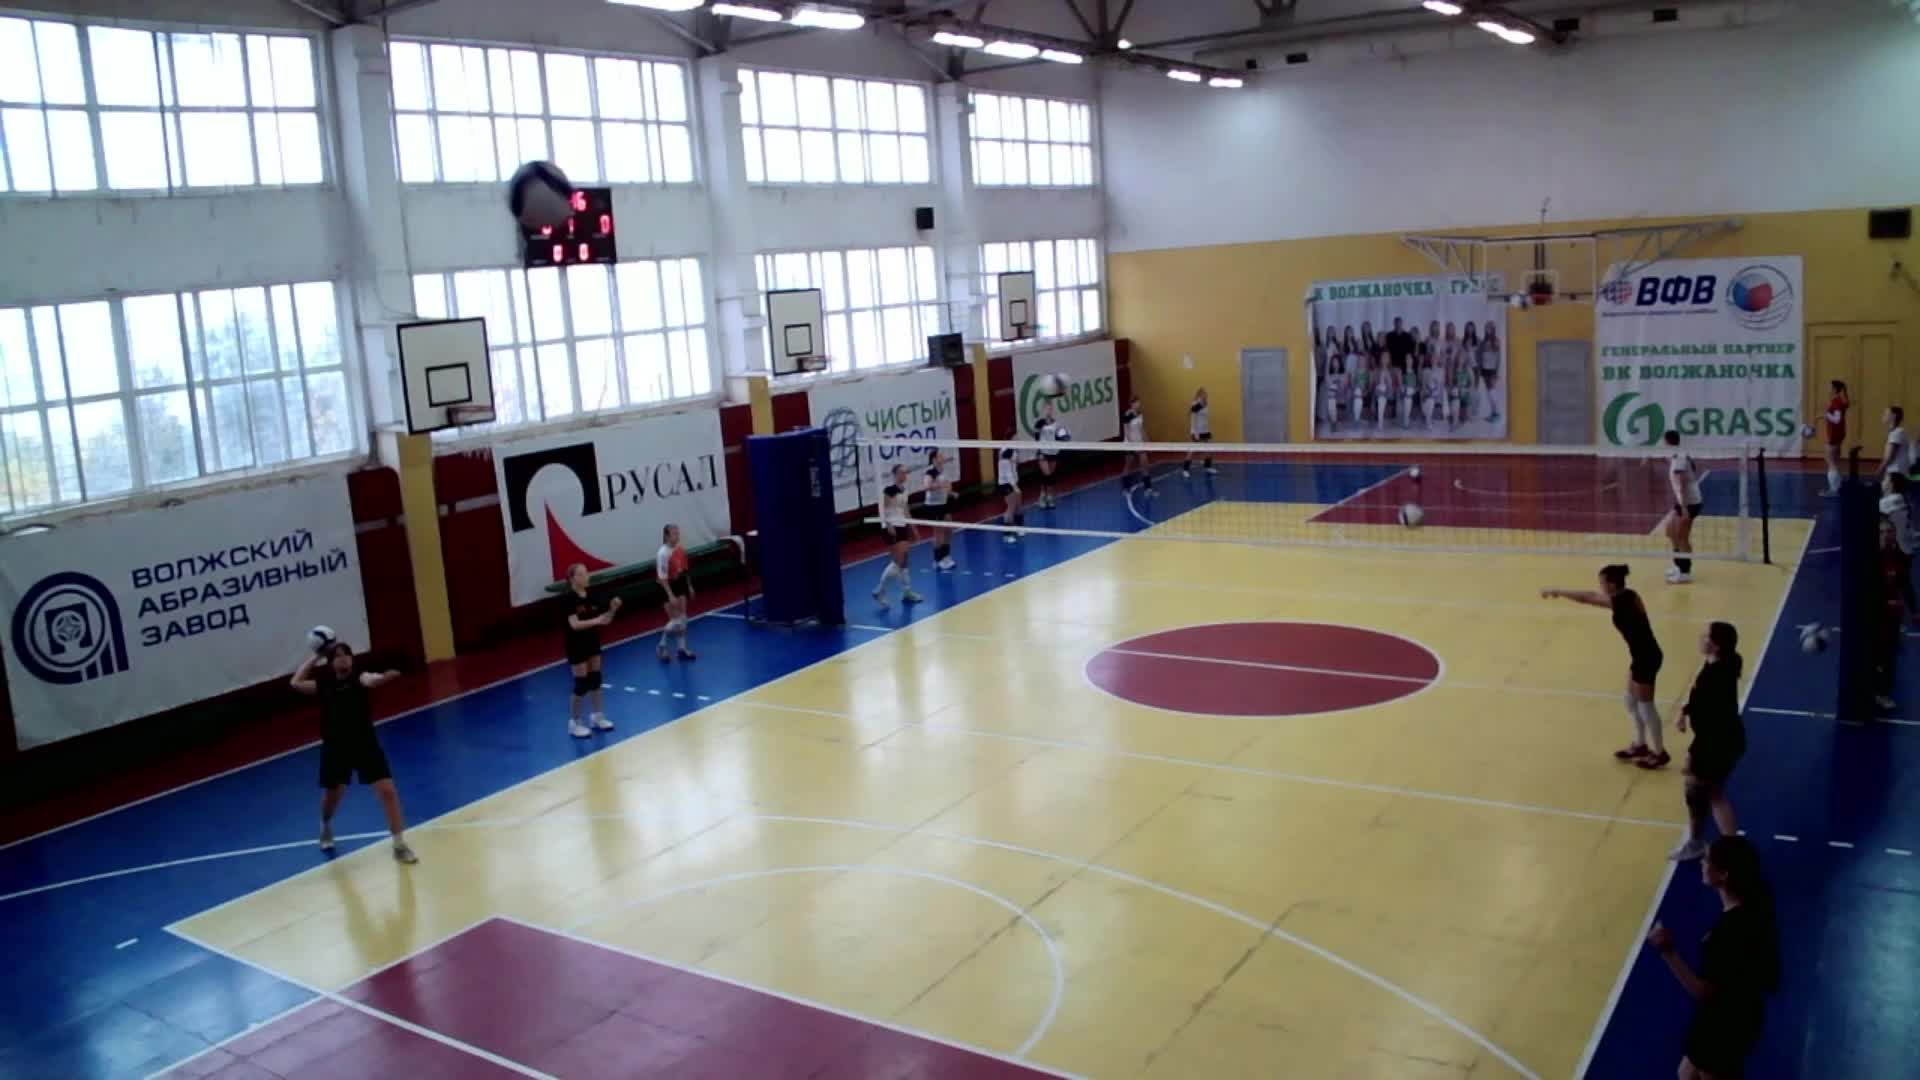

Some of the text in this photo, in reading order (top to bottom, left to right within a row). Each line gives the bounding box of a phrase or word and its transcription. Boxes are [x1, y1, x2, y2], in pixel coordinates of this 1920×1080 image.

[600, 215, 610, 234] 0
[1636, 275, 1717, 306] ВФВ
[1603, 343, 1796, 356] ГЕНЕРАЛЬНЫЙ ПАРТНЕР
[1603, 364, 1796, 381] ВК ВОЛЖАНОЧКА
[865, 390, 951, 432] ЧИСТЫЙ
[1675, 407, 1796, 437] GRASS
[602, 453, 719, 512] РУСАЛ
[131, 529, 314, 589] ВОЛЖСКИЙ
[137, 549, 348, 618] АБРАЗИВНЫЙ
[141, 603, 250, 647] ЗАВОД
